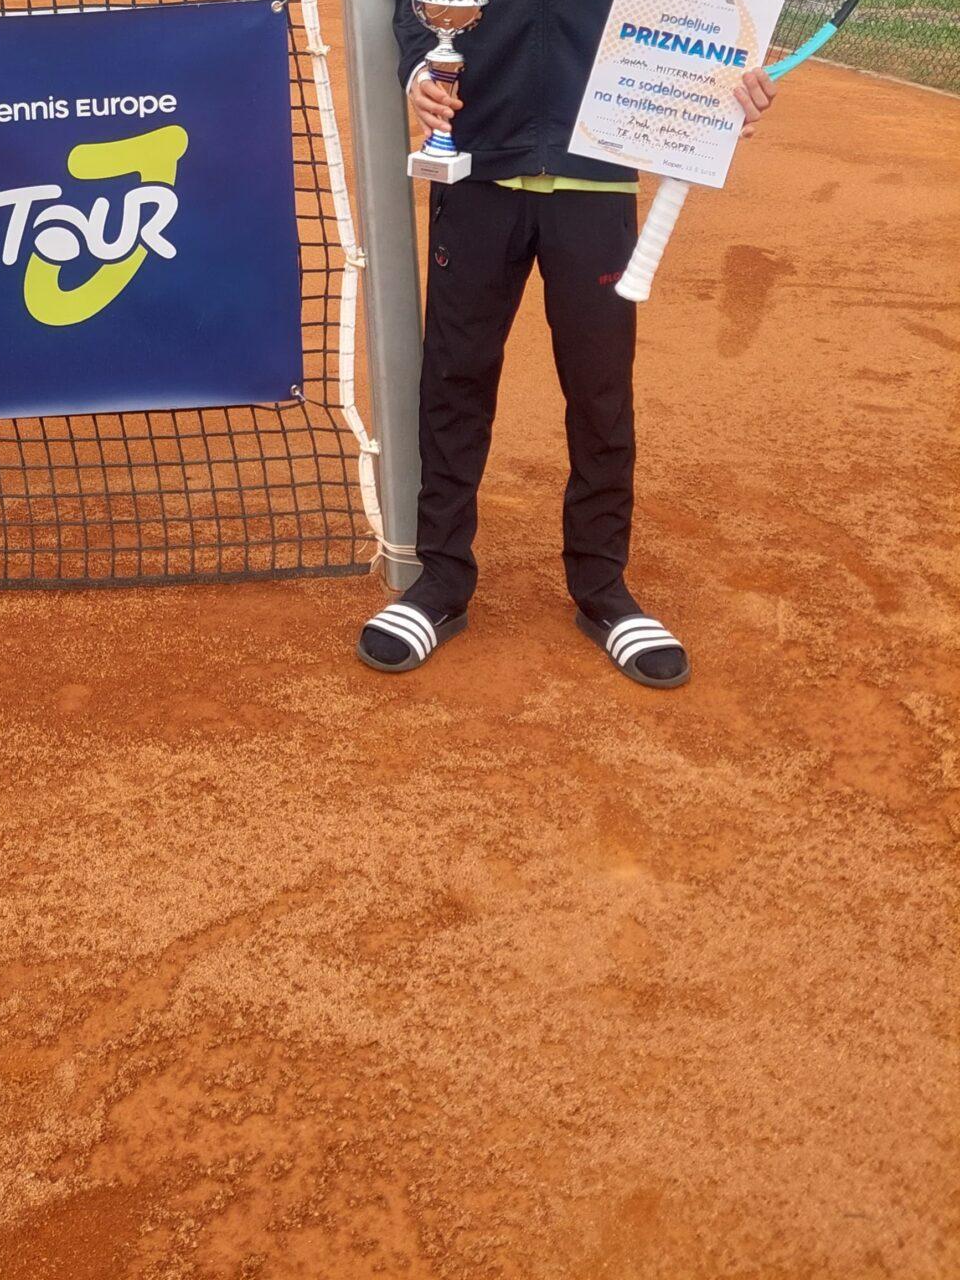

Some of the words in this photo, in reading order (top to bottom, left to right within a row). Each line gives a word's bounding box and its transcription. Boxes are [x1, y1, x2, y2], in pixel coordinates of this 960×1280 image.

[660, 12, 721, 34] podeljuje
[619, 22, 748, 68] PRIZNANJE
[618, 75, 636, 88] za
[639, 80, 721, 108] sodelovanje
[75, 94, 178, 119] Europe
[594, 90, 613, 102] na
[682, 108, 734, 131] turnirju
[663, 139, 696, 153] KOPER
